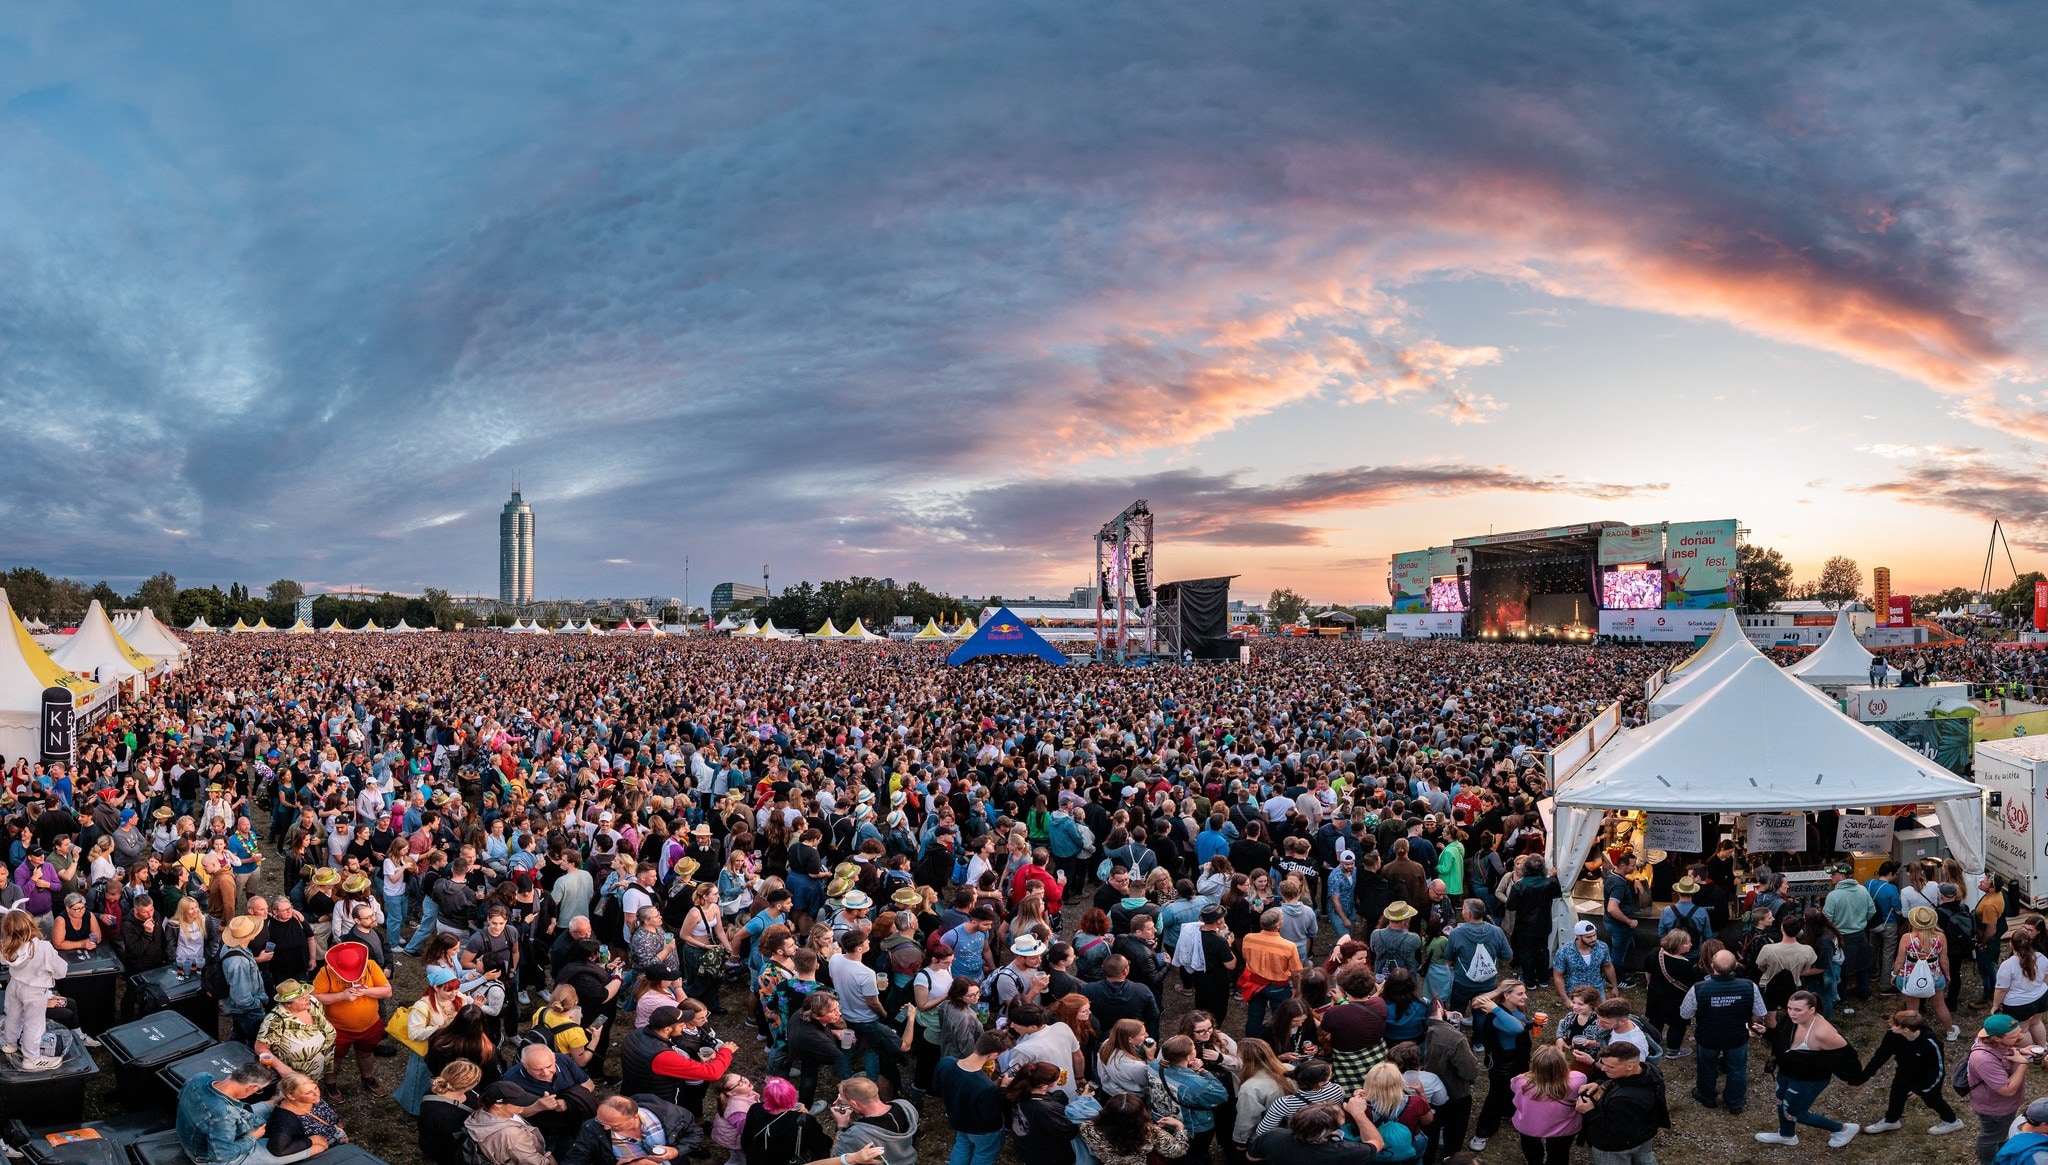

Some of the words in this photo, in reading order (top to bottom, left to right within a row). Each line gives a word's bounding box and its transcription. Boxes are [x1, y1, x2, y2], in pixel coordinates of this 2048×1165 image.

[1680, 536, 1716, 546] donau
[1672, 548, 1698, 558] insel
[1398, 562, 1418, 570] donau
[1705, 556, 1728, 566] fest.
[1872, 703, 1883, 712] 30
[2011, 807, 2024, 825] 30
[1756, 817, 1796, 828] SPRITZEREI
[1845, 818, 1868, 829] Saurer
[1868, 818, 1888, 830] Radler
[1842, 829, 1865, 839] Radler
[1990, 835, 2008, 851] 02166
[2010, 844, 2027, 860] 2244
